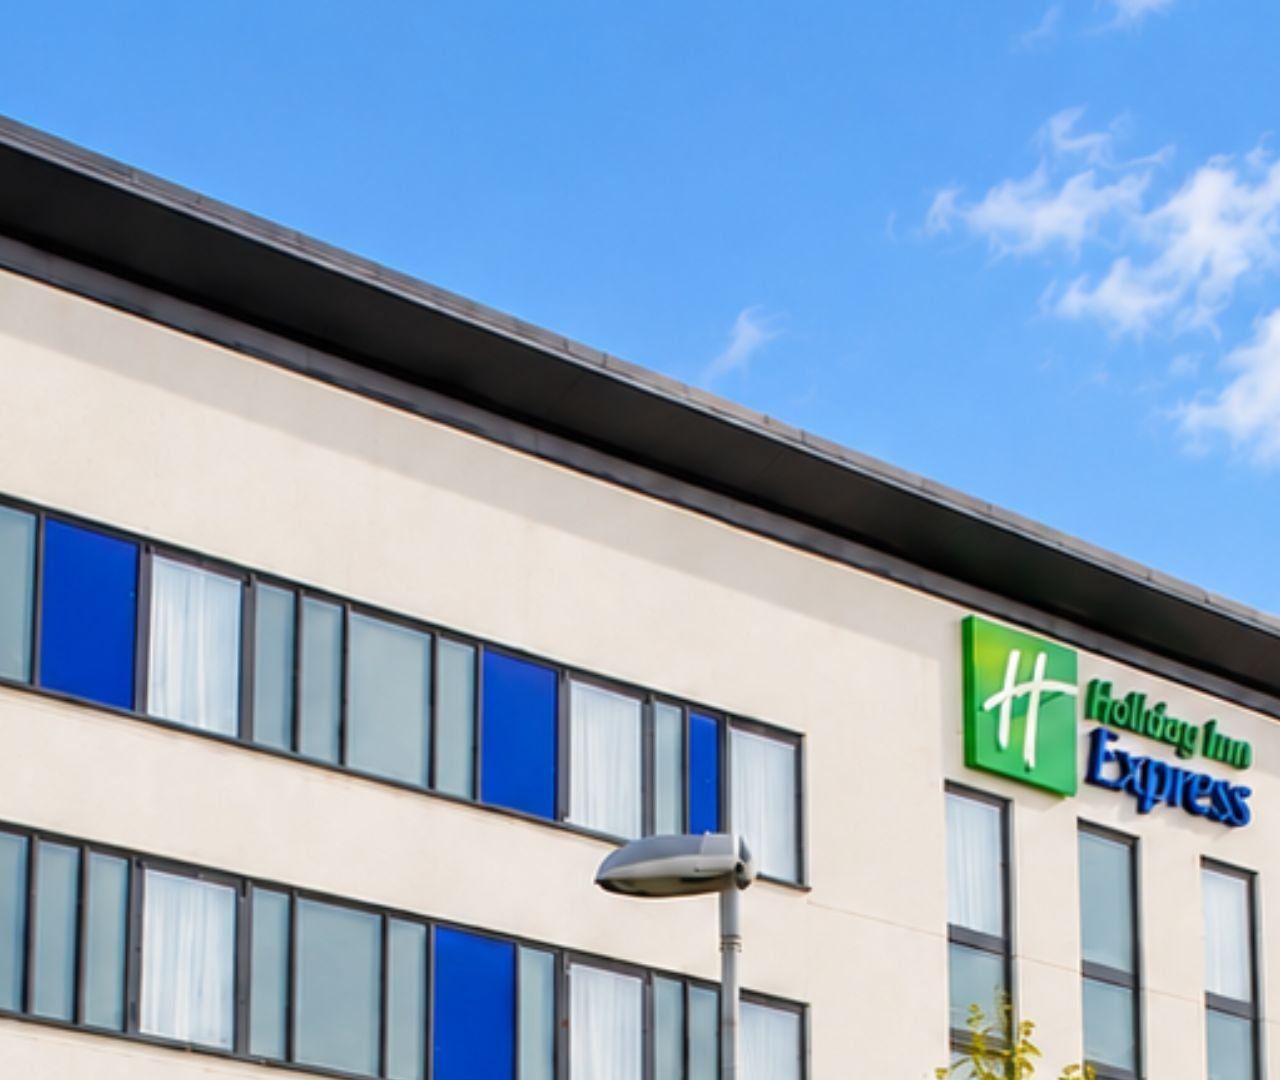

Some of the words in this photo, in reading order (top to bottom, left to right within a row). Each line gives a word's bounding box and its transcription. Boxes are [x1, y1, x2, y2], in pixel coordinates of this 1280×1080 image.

[1085, 679, 1198, 759] Holiday
[1201, 719, 1252, 770] Inn
[1084, 727, 1252, 827] Express
